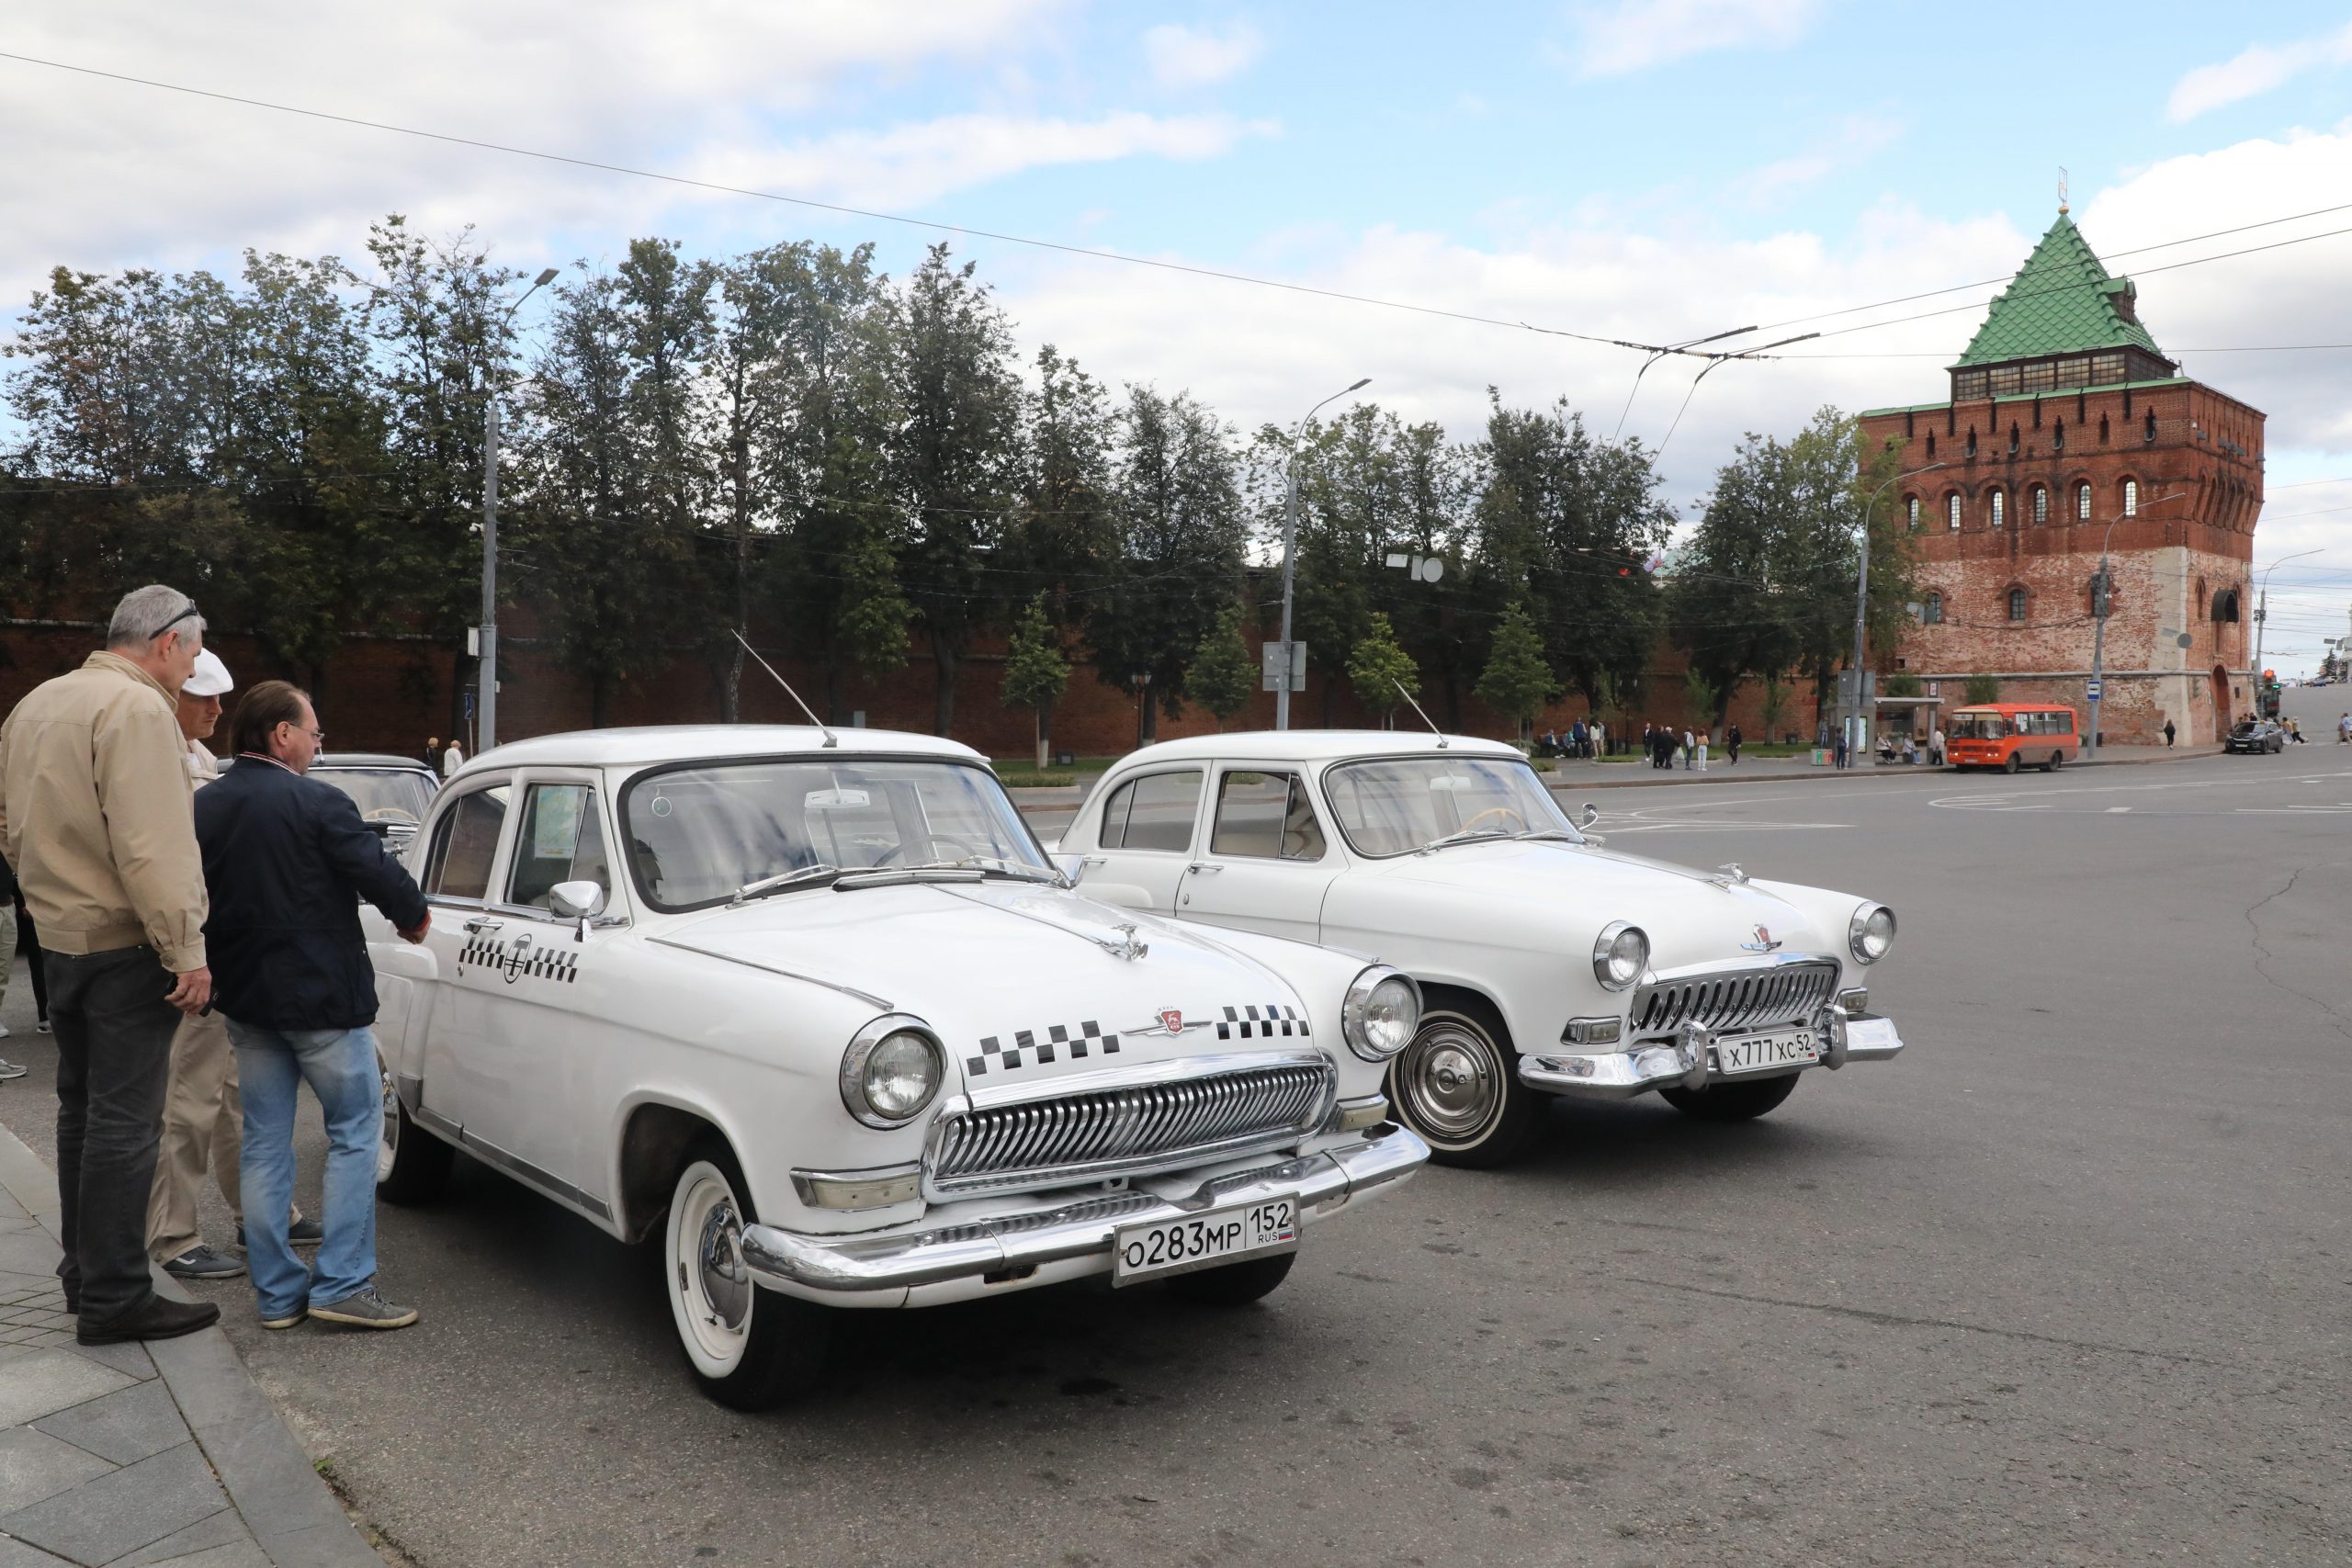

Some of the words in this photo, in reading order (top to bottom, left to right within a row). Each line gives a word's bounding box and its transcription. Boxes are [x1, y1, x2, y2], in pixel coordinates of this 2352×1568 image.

[1796, 1034, 1811, 1052] 52
[1250, 1202, 1289, 1233] 152
[1258, 1231, 1278, 1244] RUS
